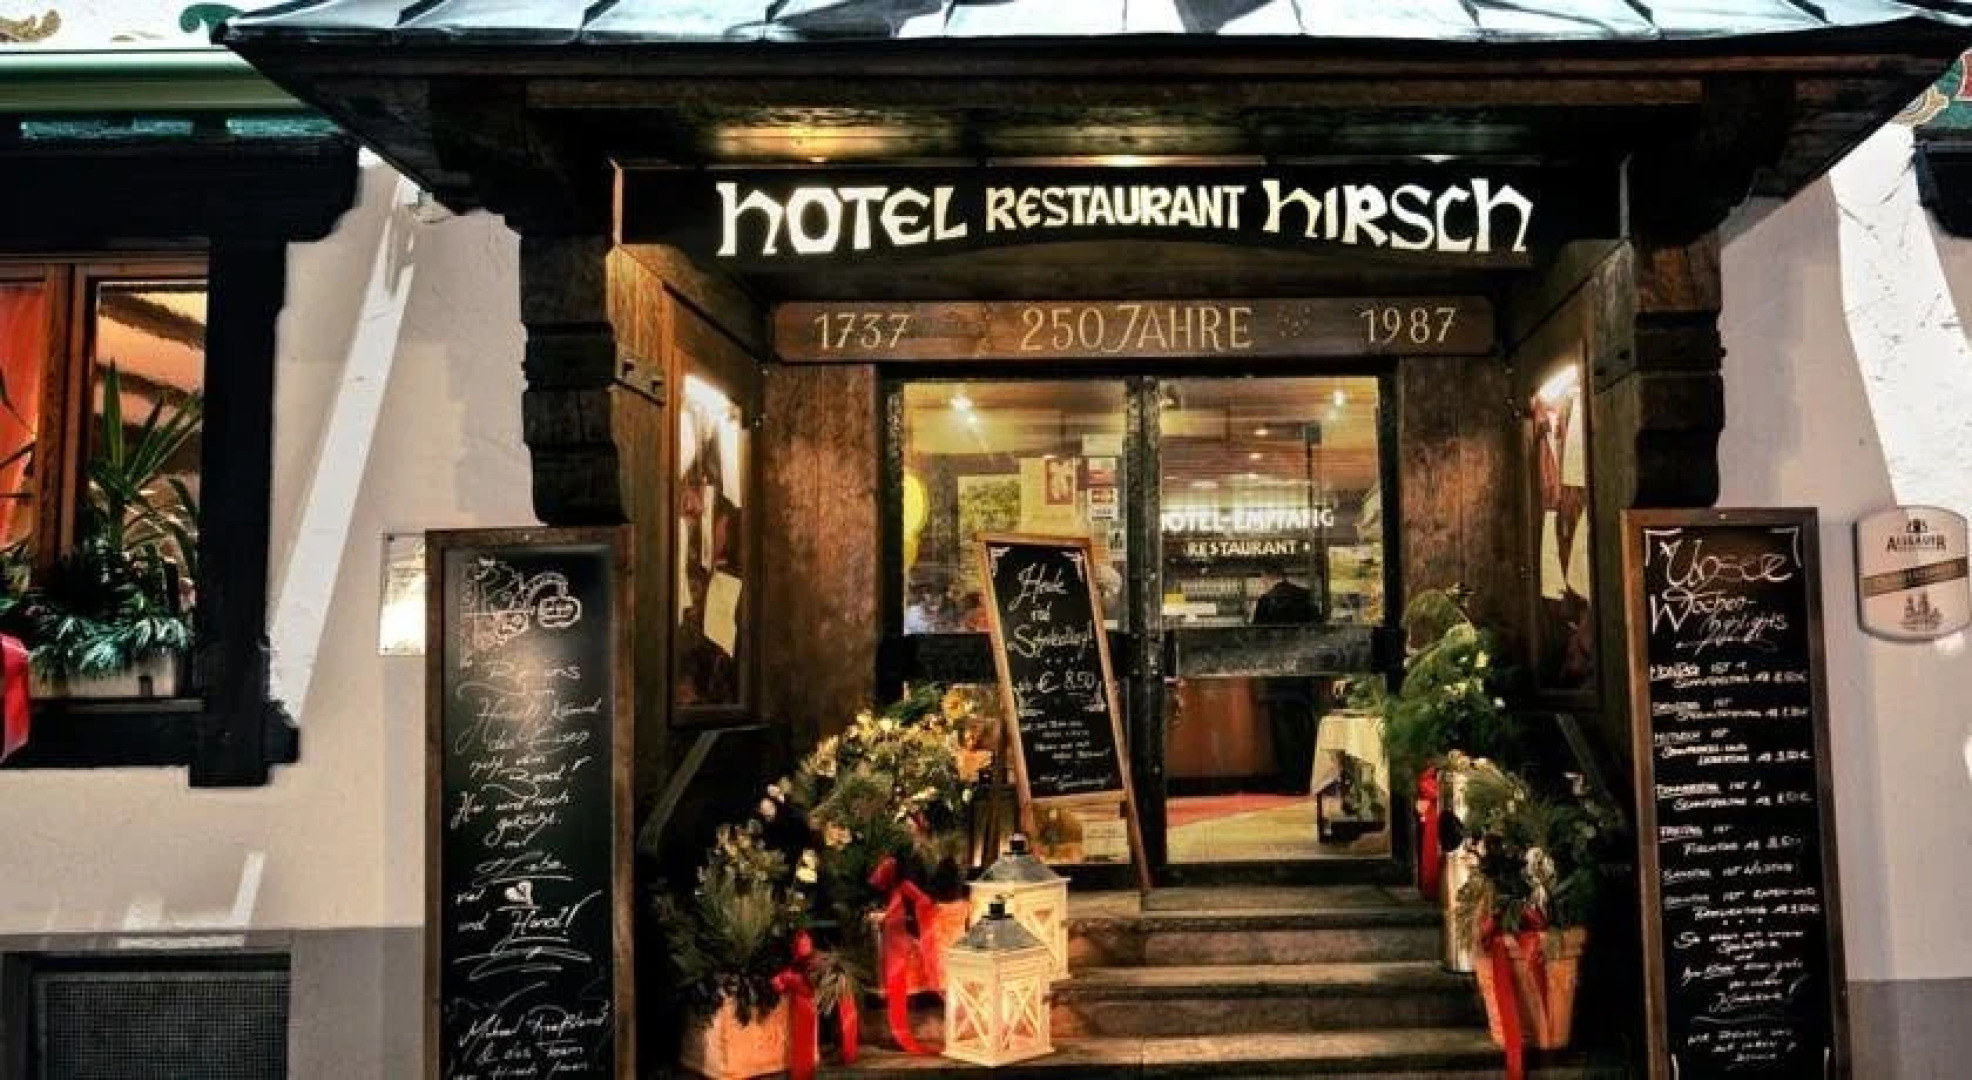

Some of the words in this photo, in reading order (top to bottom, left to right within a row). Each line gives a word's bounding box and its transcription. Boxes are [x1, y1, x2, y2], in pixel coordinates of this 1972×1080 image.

[716, 182, 968, 257] HOTEL
[985, 186, 1246, 231] RESTAURANT
[1262, 178, 1534, 252] HIRSCH
[814, 313, 909, 349] 1737
[1021, 307, 1103, 350] 250
[1103, 304, 1252, 350] JAHRE
[1360, 307, 1456, 344] 1987
[1188, 540, 1297, 556] RESTAURANT
